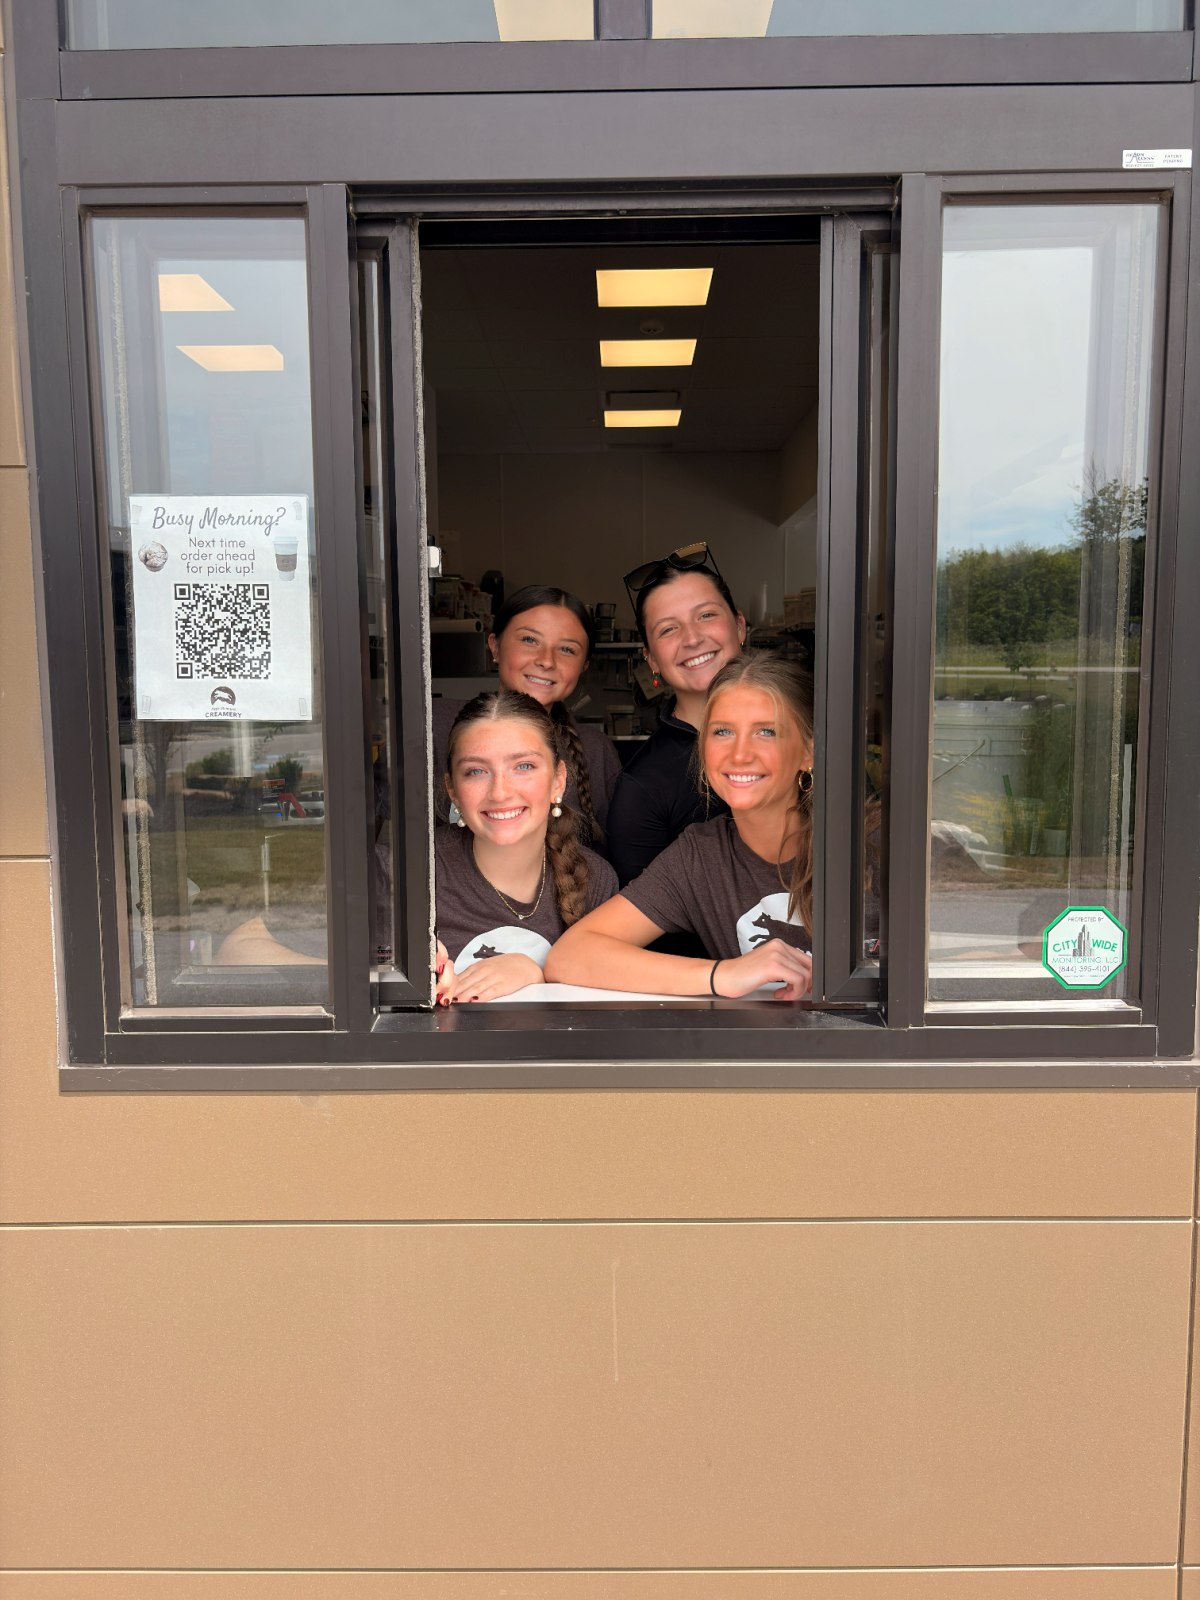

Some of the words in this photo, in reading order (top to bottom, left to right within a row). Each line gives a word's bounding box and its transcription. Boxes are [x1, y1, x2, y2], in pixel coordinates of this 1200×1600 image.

[152, 506, 194, 534] Busy
[199, 506, 286, 536] Morning?
[189, 537, 216, 548] Next
[220, 537, 246, 548] time
[180, 549, 213, 561] order
[216, 549, 256, 561] ahead
[186, 562, 203, 574] for
[207, 562, 231, 576] pick
[235, 562, 254, 576] up!
[1052, 939, 1077, 953] CITY
[1092, 939, 1118, 952] WIDE
[1106, 956, 1119, 964] LLC
